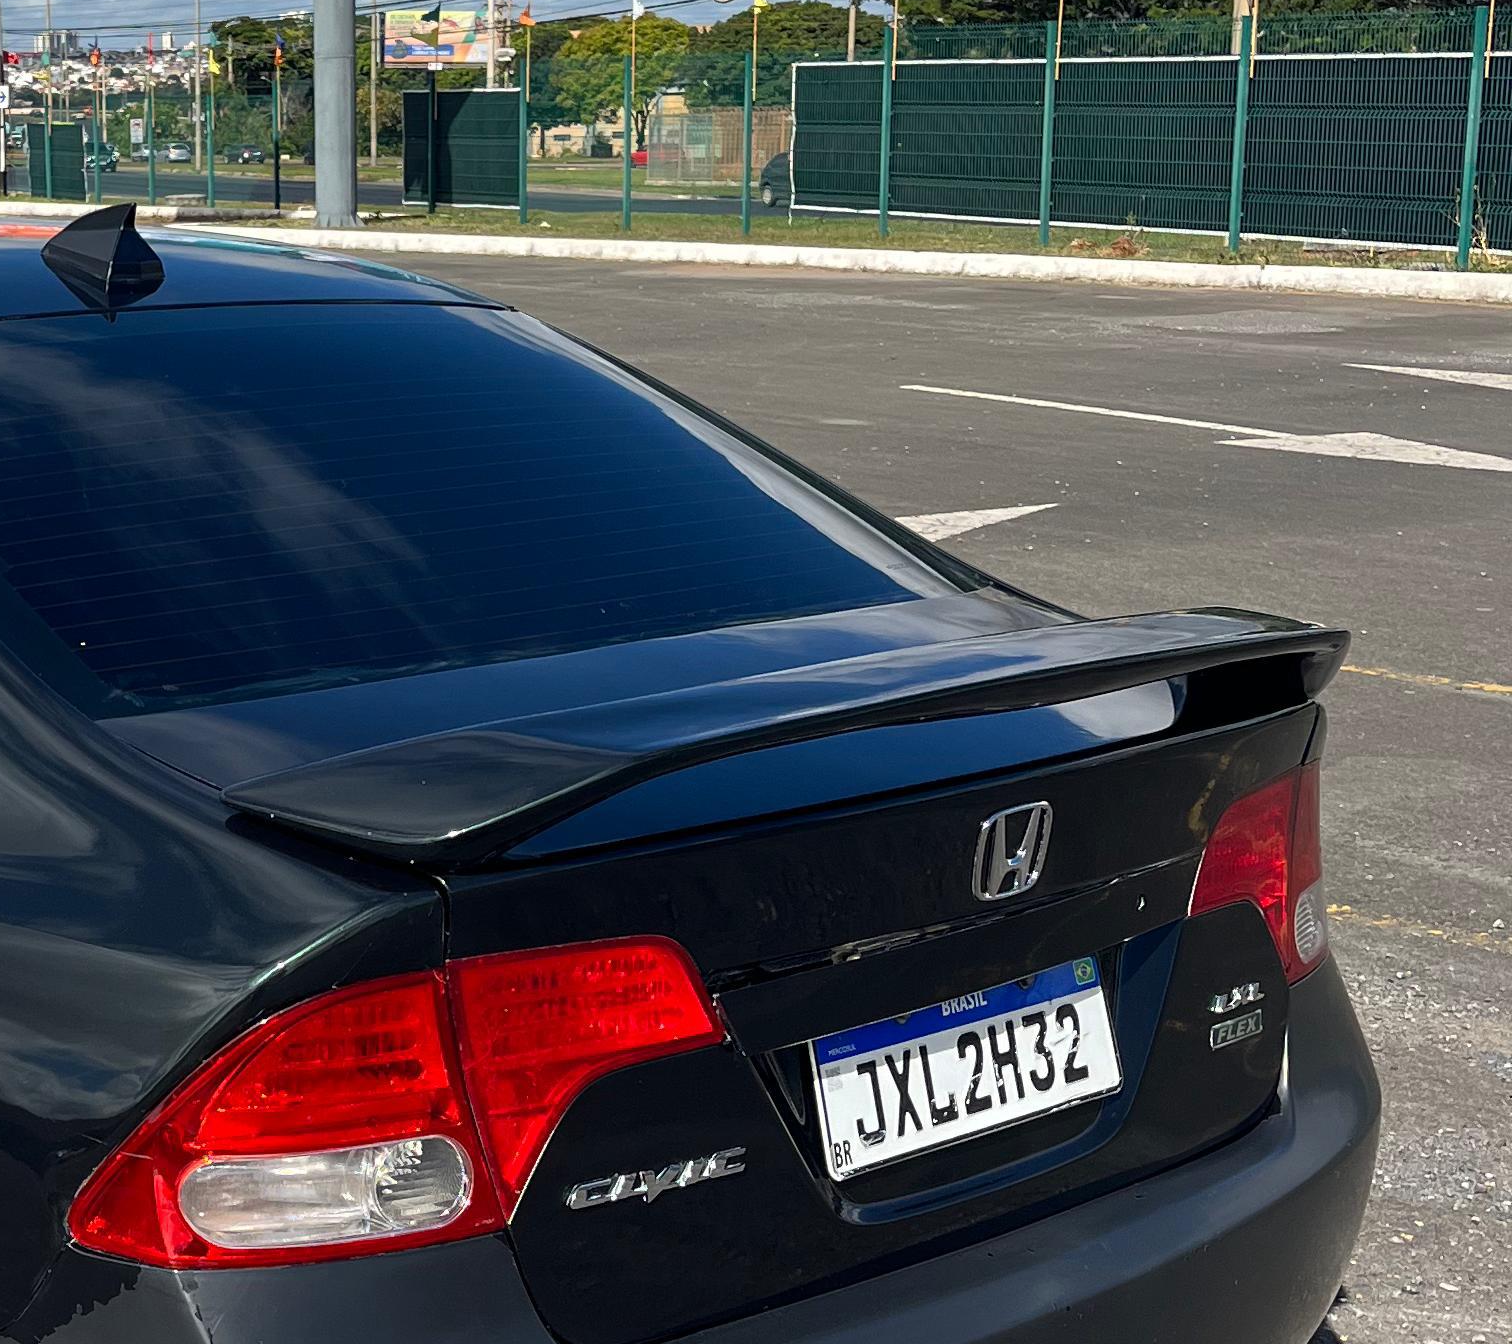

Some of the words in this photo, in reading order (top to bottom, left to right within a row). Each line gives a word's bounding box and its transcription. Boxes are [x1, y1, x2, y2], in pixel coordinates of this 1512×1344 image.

[941, 991, 988, 1017] BRASIL
[1216, 1016, 1258, 1044] FLEX
[855, 1003, 1090, 1148] JXL2H32
[833, 1139, 854, 1169] BR
[565, 1146, 748, 1211] CIVIC
